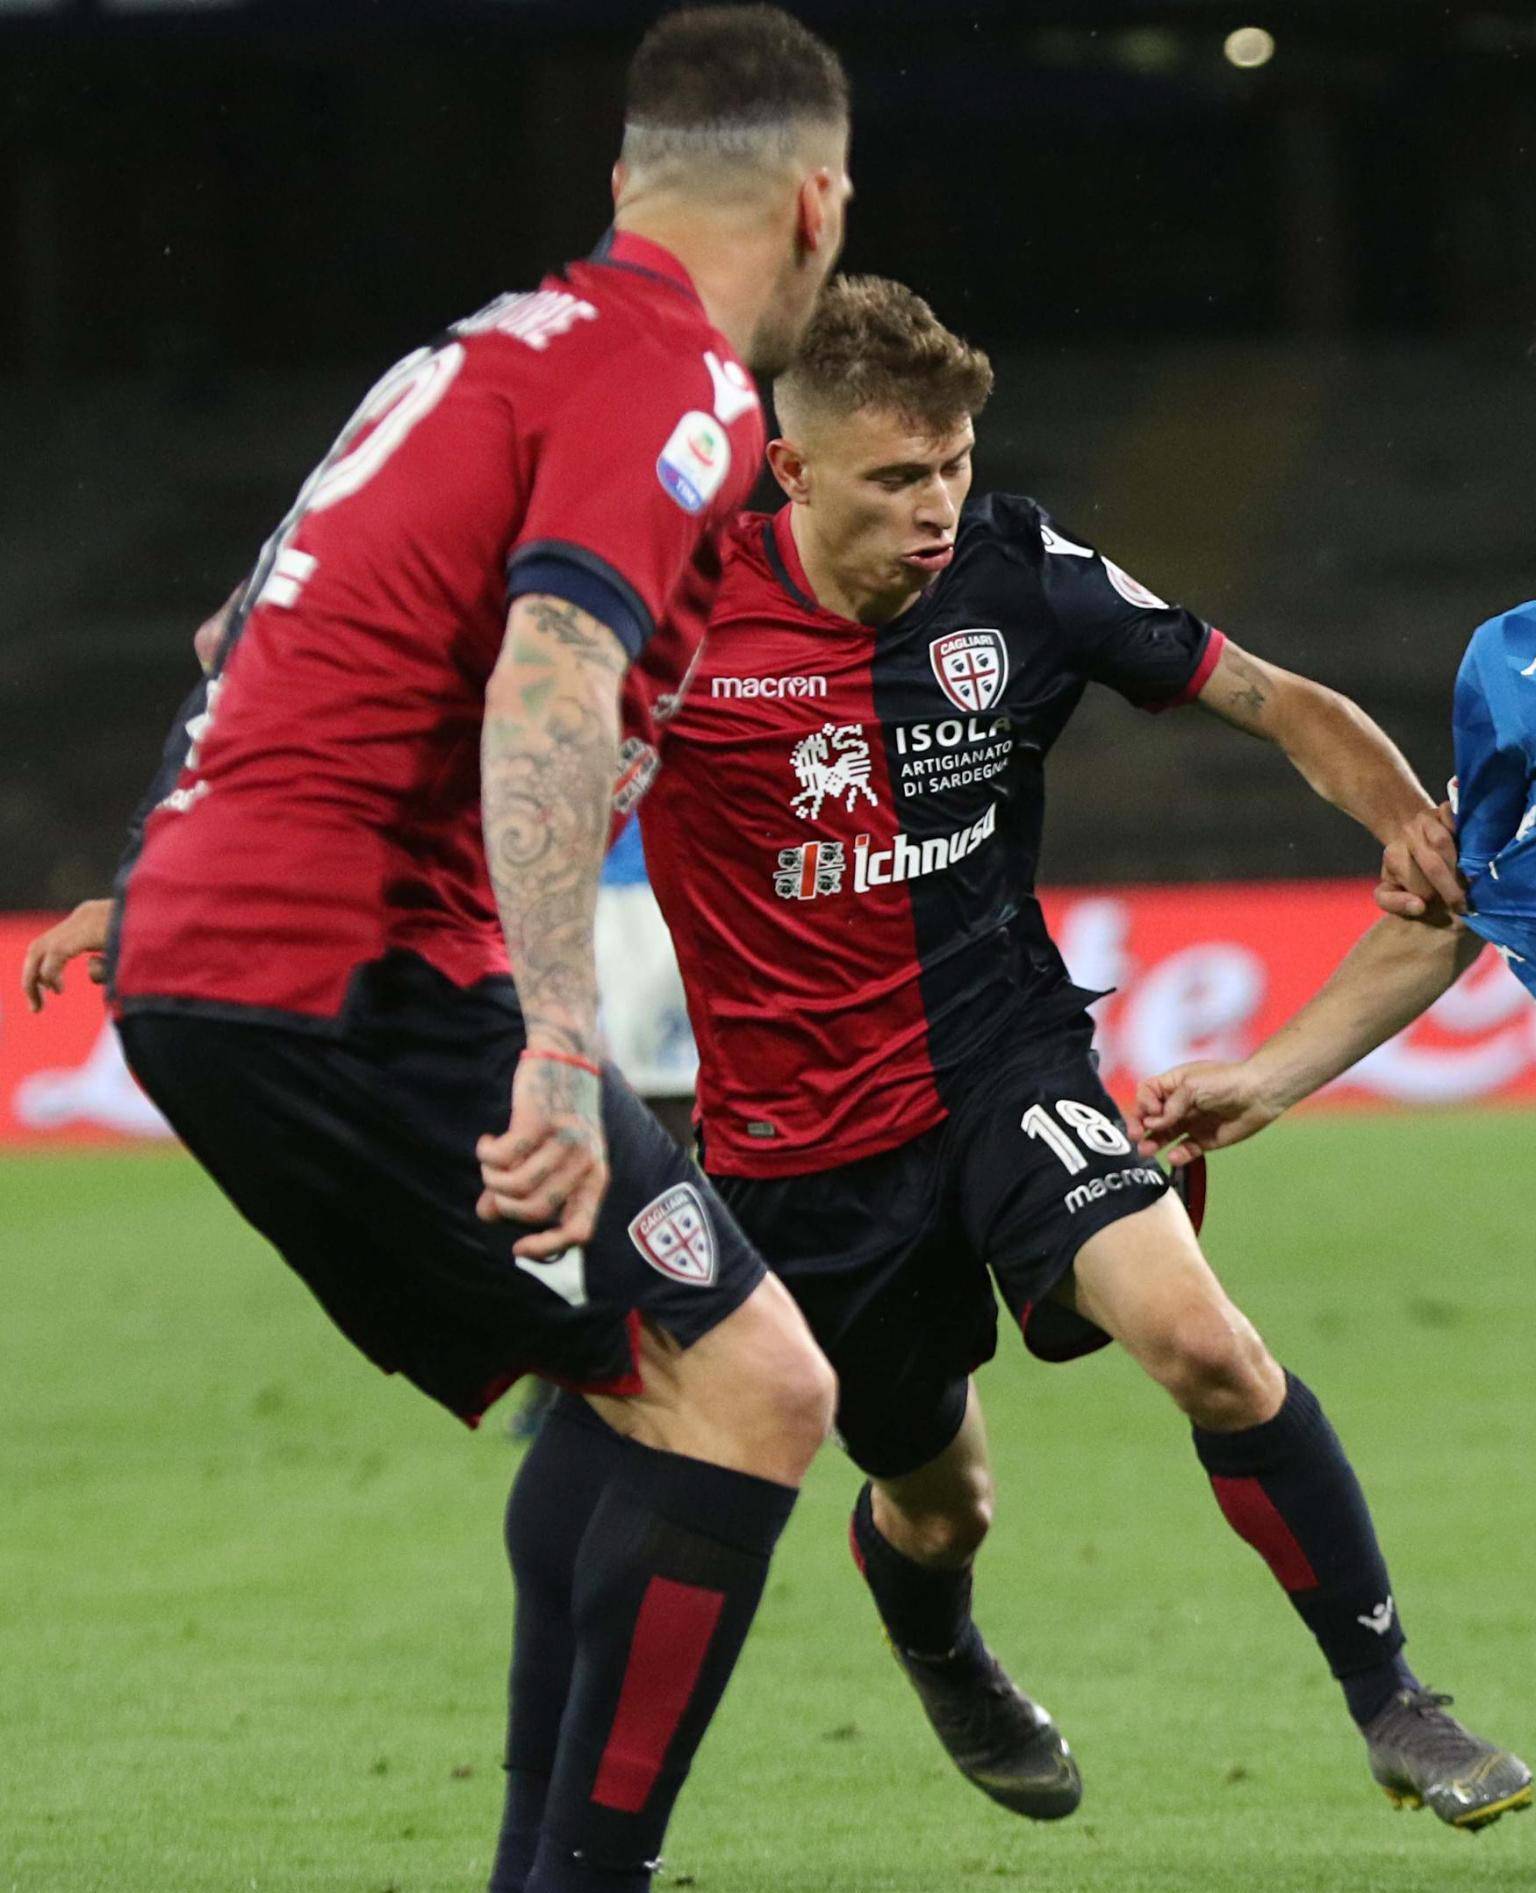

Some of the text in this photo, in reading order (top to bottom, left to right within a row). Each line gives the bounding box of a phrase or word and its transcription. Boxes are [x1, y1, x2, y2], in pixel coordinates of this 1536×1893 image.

[940, 635, 994, 655] CAGLIARI
[711, 675, 828, 699] macron
[896, 716, 1011, 755] ISOLA
[901, 740, 1013, 778] ARTIGIANATO
[903, 758, 1009, 798] DI SARDEGNA
[1020, 1099, 1132, 1176] 18
[1063, 1167, 1165, 1215] macron
[639, 1192, 690, 1235] CAGLIARI
